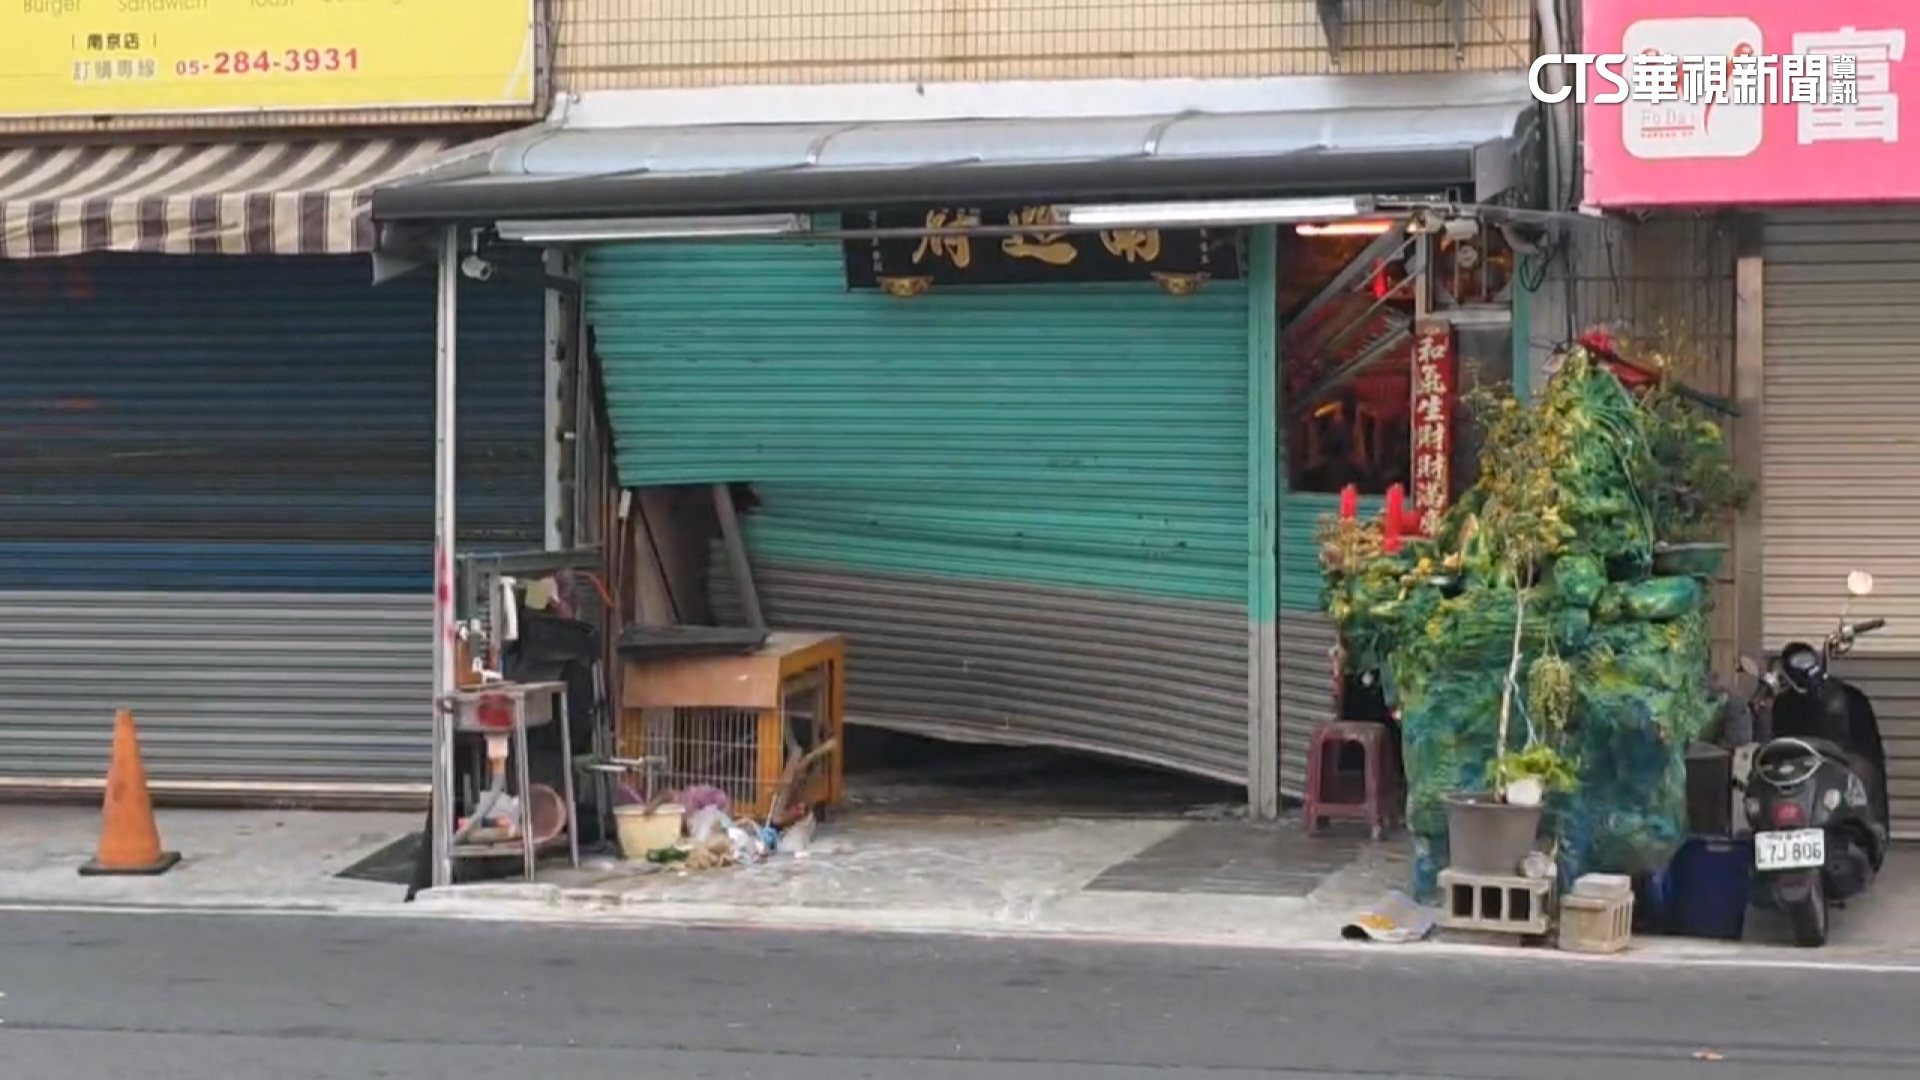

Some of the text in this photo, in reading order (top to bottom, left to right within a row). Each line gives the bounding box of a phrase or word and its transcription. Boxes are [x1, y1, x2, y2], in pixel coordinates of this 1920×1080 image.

[87, 32, 139, 50] 南京店
[176, 47, 359, 76] 05-284-3931
[1791, 26, 1906, 144] 富
